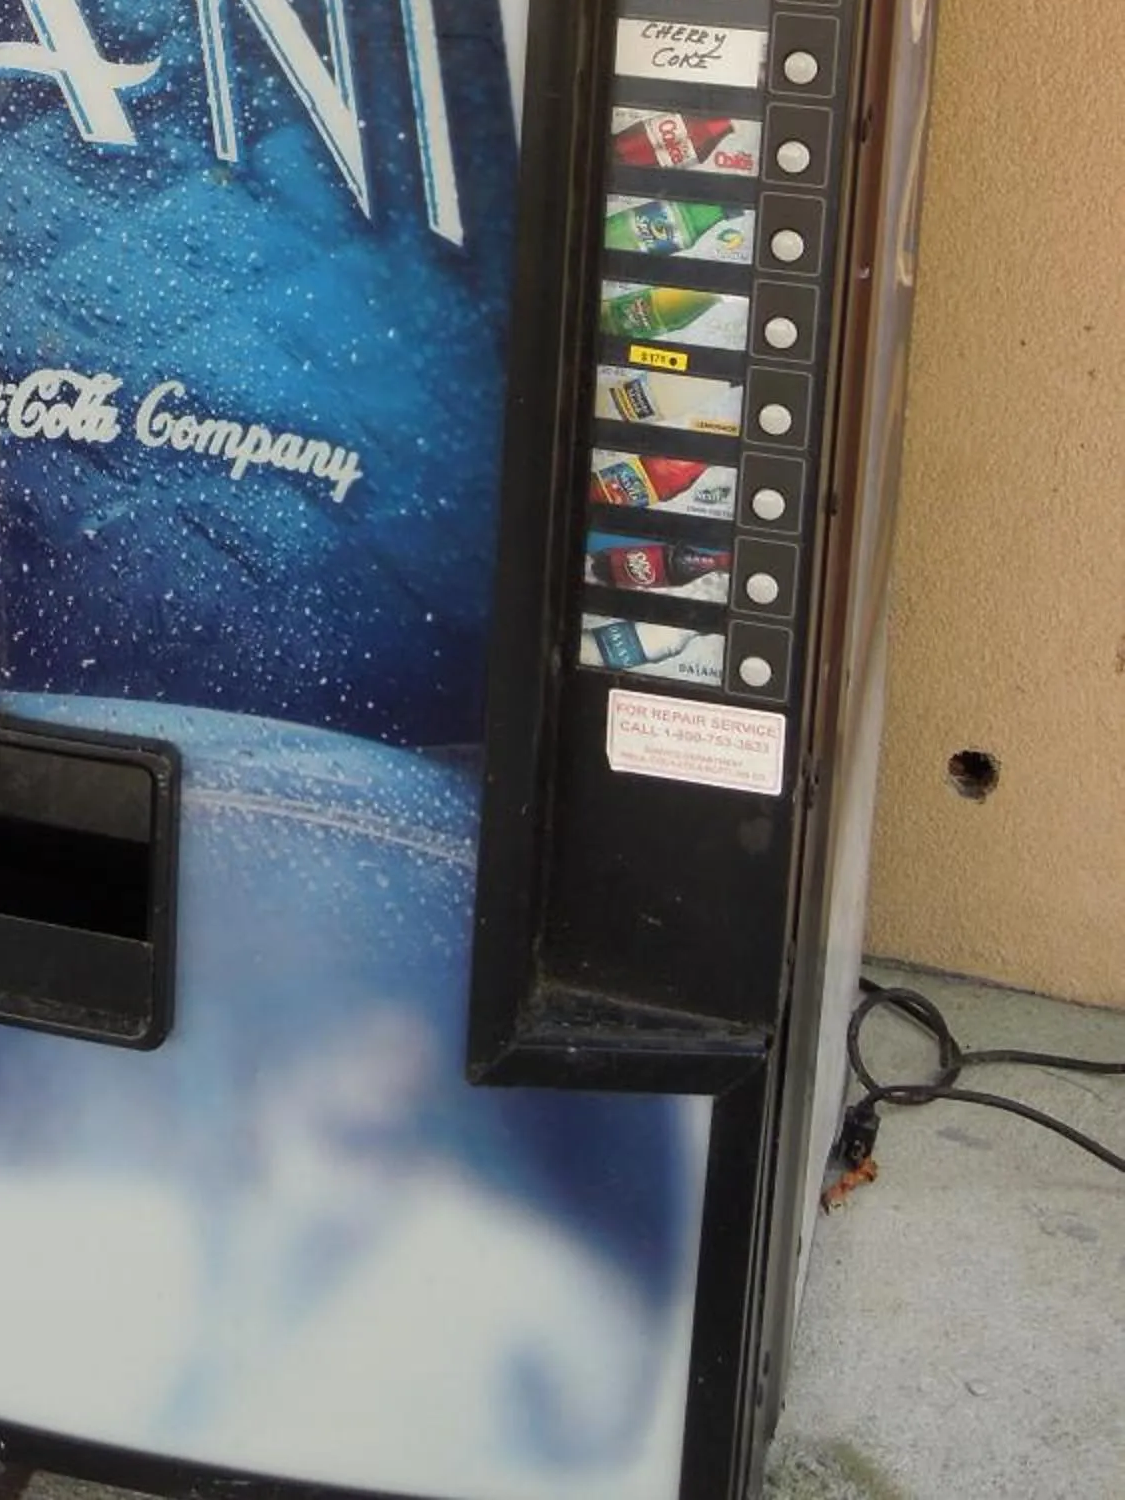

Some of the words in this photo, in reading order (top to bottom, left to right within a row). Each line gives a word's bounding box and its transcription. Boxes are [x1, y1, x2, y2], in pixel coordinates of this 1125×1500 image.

[640, 22, 727, 58] CHERRY
[136, 378, 363, 503] Company
[620, 721, 658, 737] CALL
[652, 707, 707, 728] REPAIR
[711, 717, 778, 739] SERVICE
